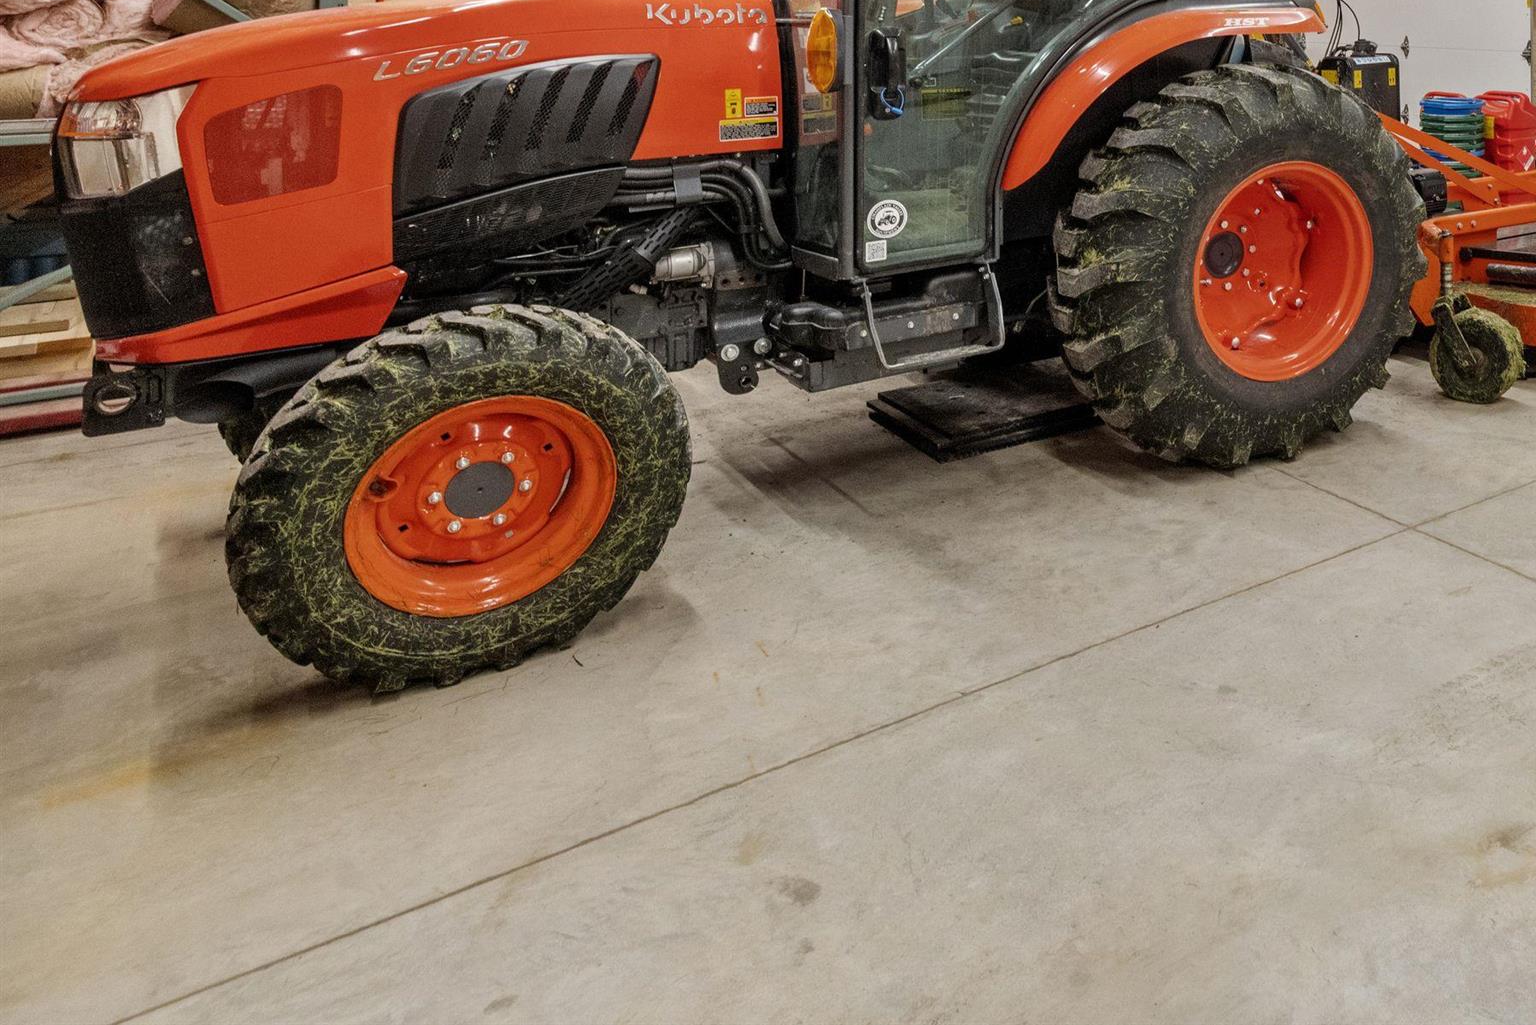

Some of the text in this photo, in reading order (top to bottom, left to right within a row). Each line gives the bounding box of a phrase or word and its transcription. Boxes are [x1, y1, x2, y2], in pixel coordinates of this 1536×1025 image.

[646, 3, 767, 25] Kubota
[1223, 17, 1270, 27] HST
[373, 40, 529, 81] L6060
